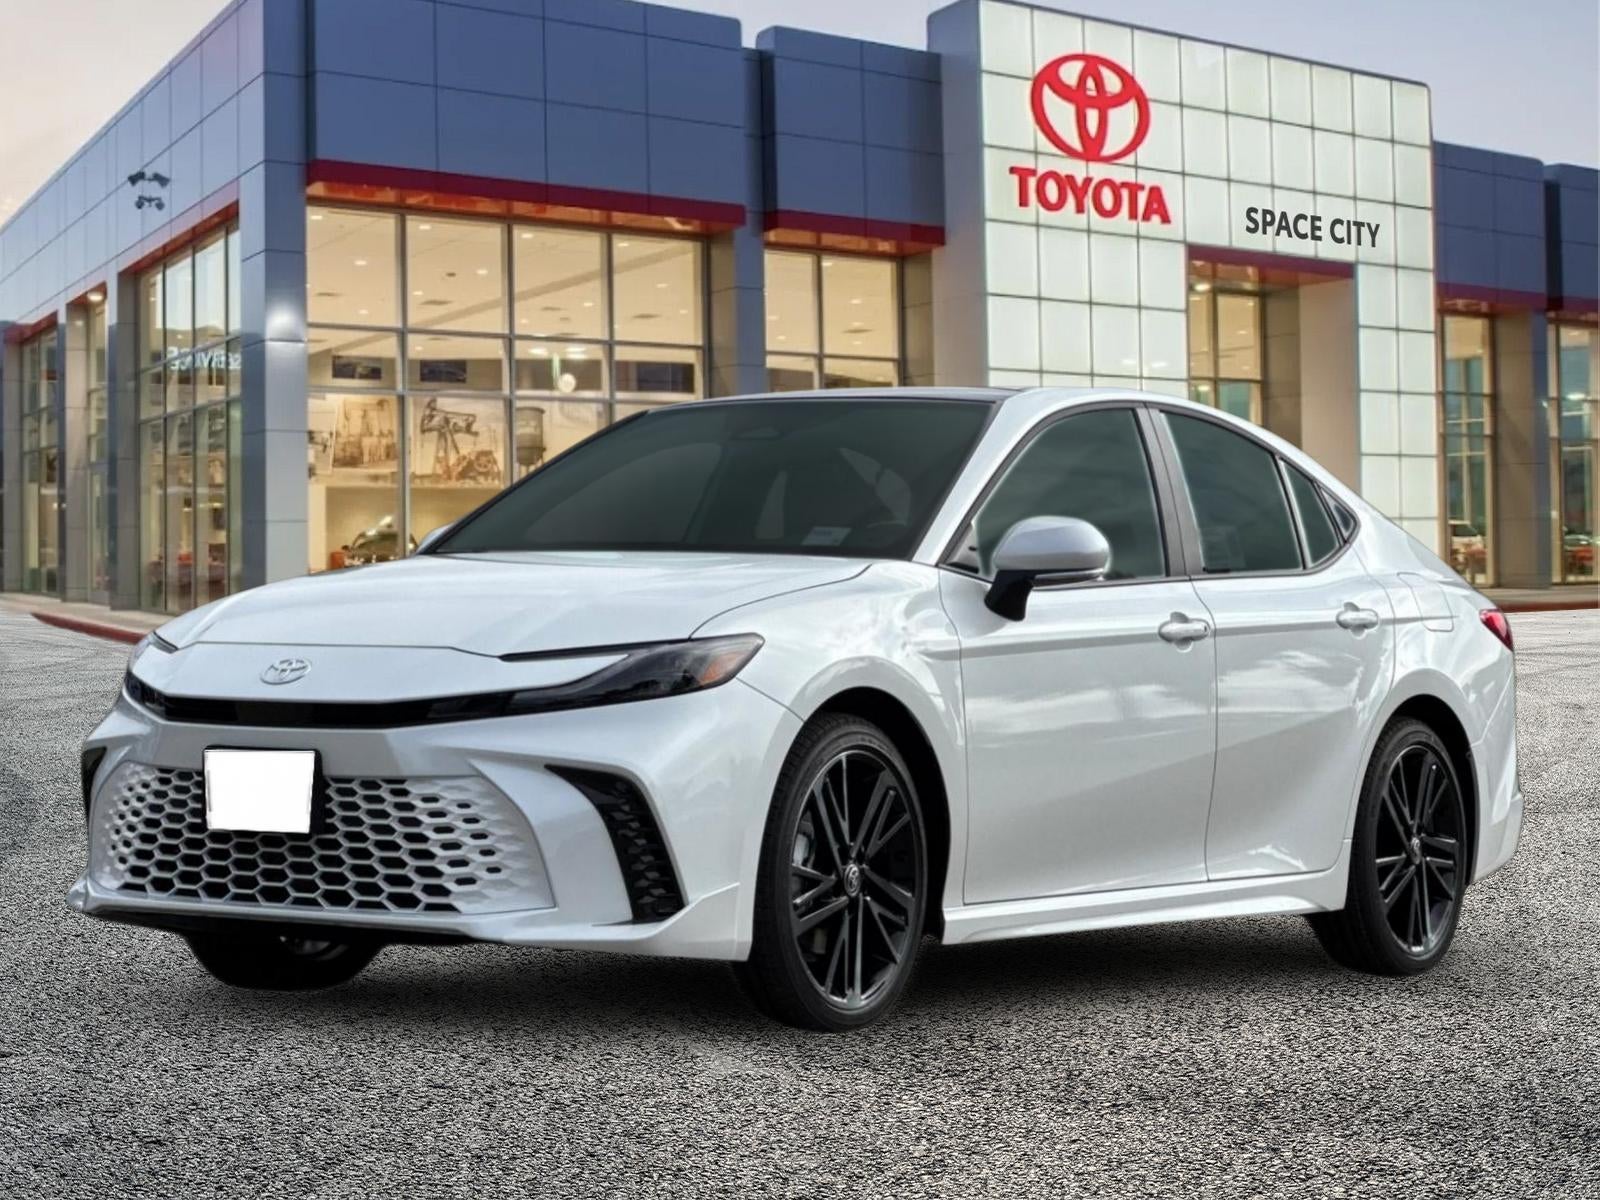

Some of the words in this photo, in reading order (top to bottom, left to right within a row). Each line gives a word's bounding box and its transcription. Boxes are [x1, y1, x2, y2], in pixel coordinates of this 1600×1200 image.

[1009, 166, 1171, 224] TOYOTA
[1245, 206, 1322, 242] SPACE
[1329, 217, 1381, 248] CITY
